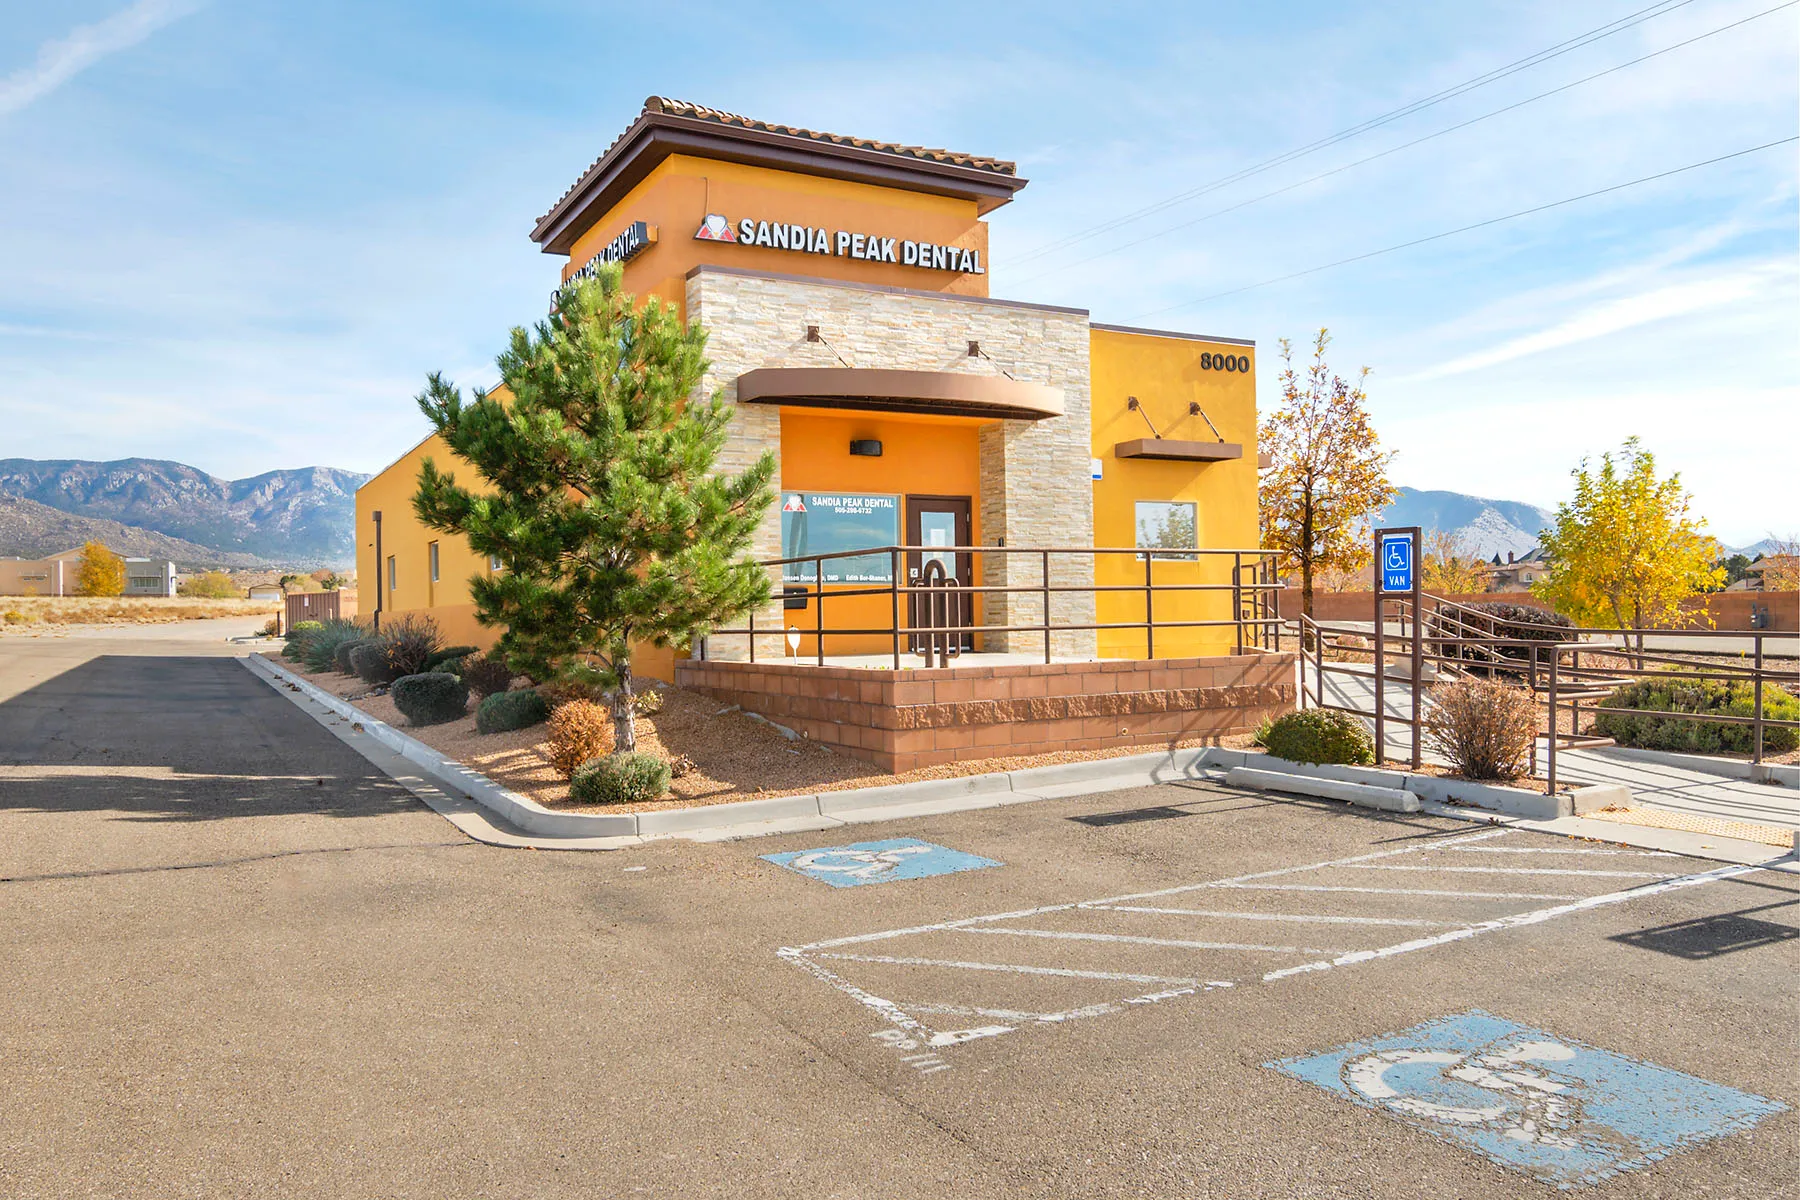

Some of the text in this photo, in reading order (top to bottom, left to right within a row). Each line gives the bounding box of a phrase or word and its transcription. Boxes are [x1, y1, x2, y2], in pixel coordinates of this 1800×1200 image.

[607, 222, 640, 266] DENTAL
[739, 218, 986, 274] SANDIA PEAK DENTAL
[1200, 352, 1250, 373] 8000
[812, 496, 894, 508] SANDIA PEAK DENTAL
[1389, 575, 1406, 586] VAN
